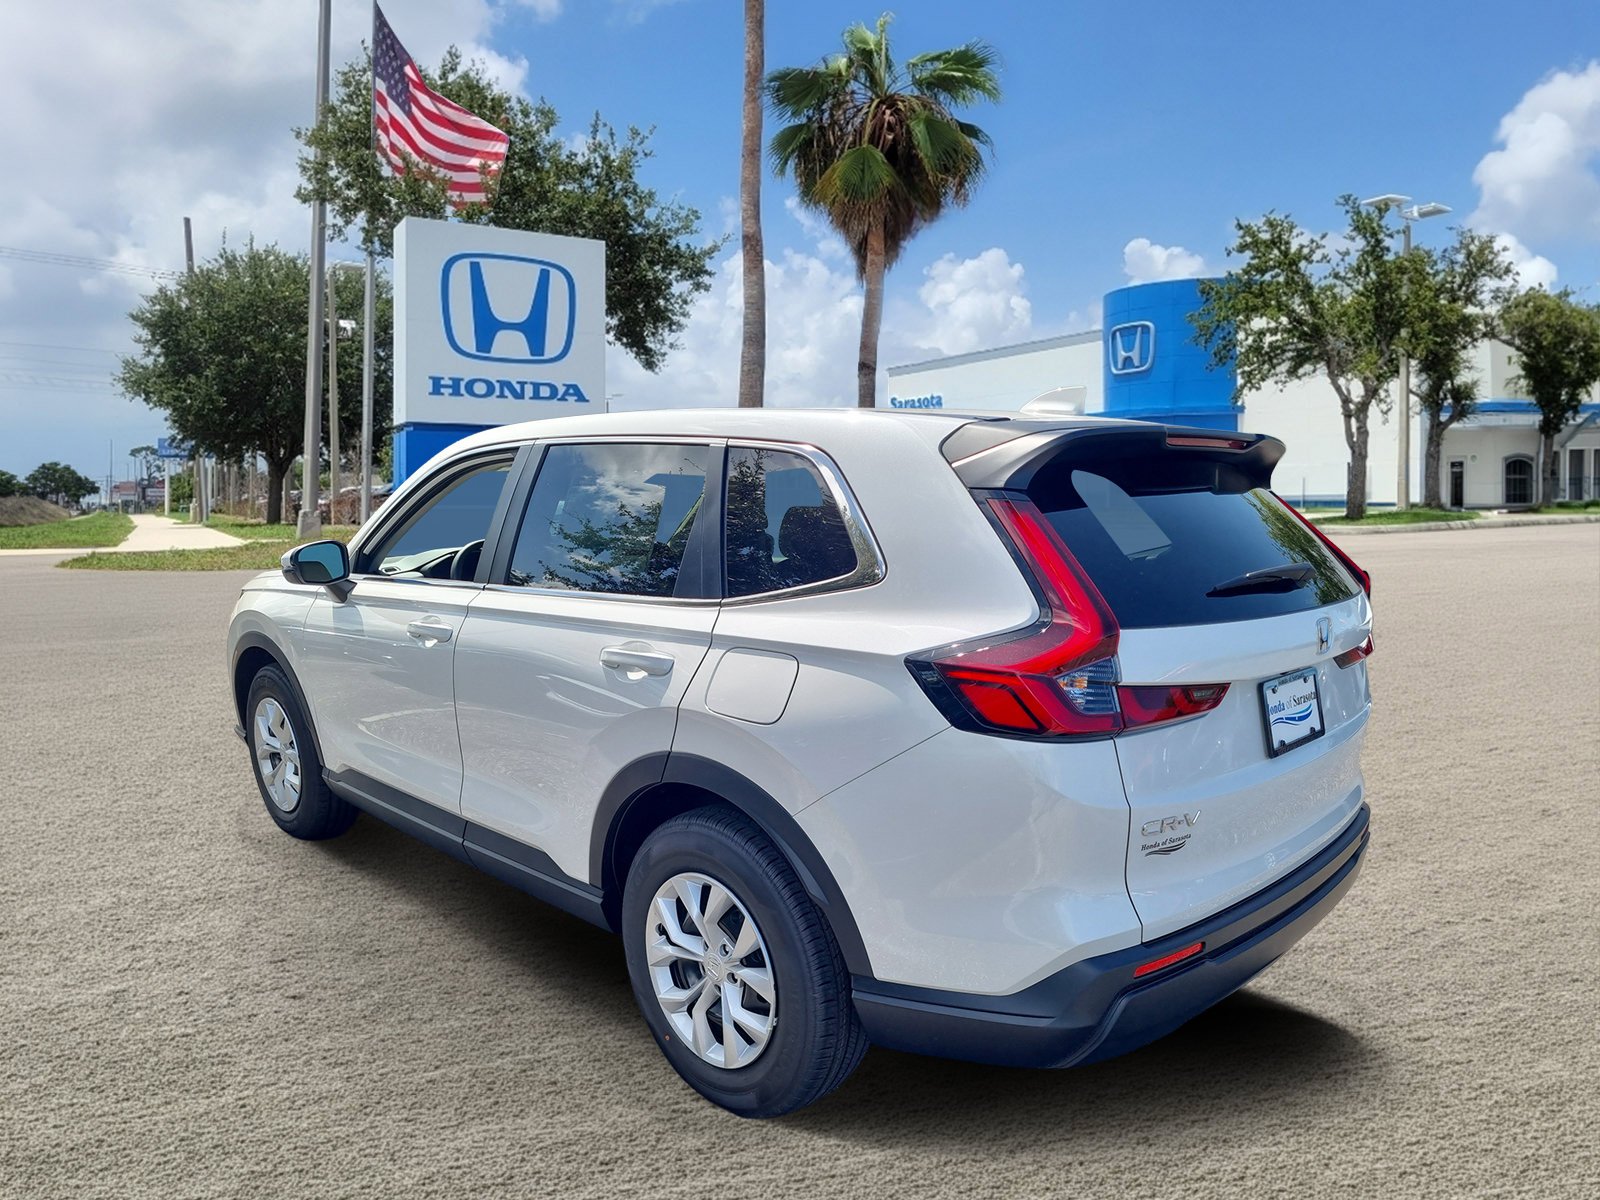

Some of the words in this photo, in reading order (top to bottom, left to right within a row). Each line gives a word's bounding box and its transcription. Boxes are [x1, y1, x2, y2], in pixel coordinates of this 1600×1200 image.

[428, 376, 590, 403] HONDA
[890, 394, 943, 408] Sarasota
[1269, 700, 1286, 715] onda
[1141, 810, 1201, 836] CR-V
[1141, 841, 1160, 851] Honda
[1161, 838, 1168, 846] of
[1168, 833, 1192, 844] Sarasota
